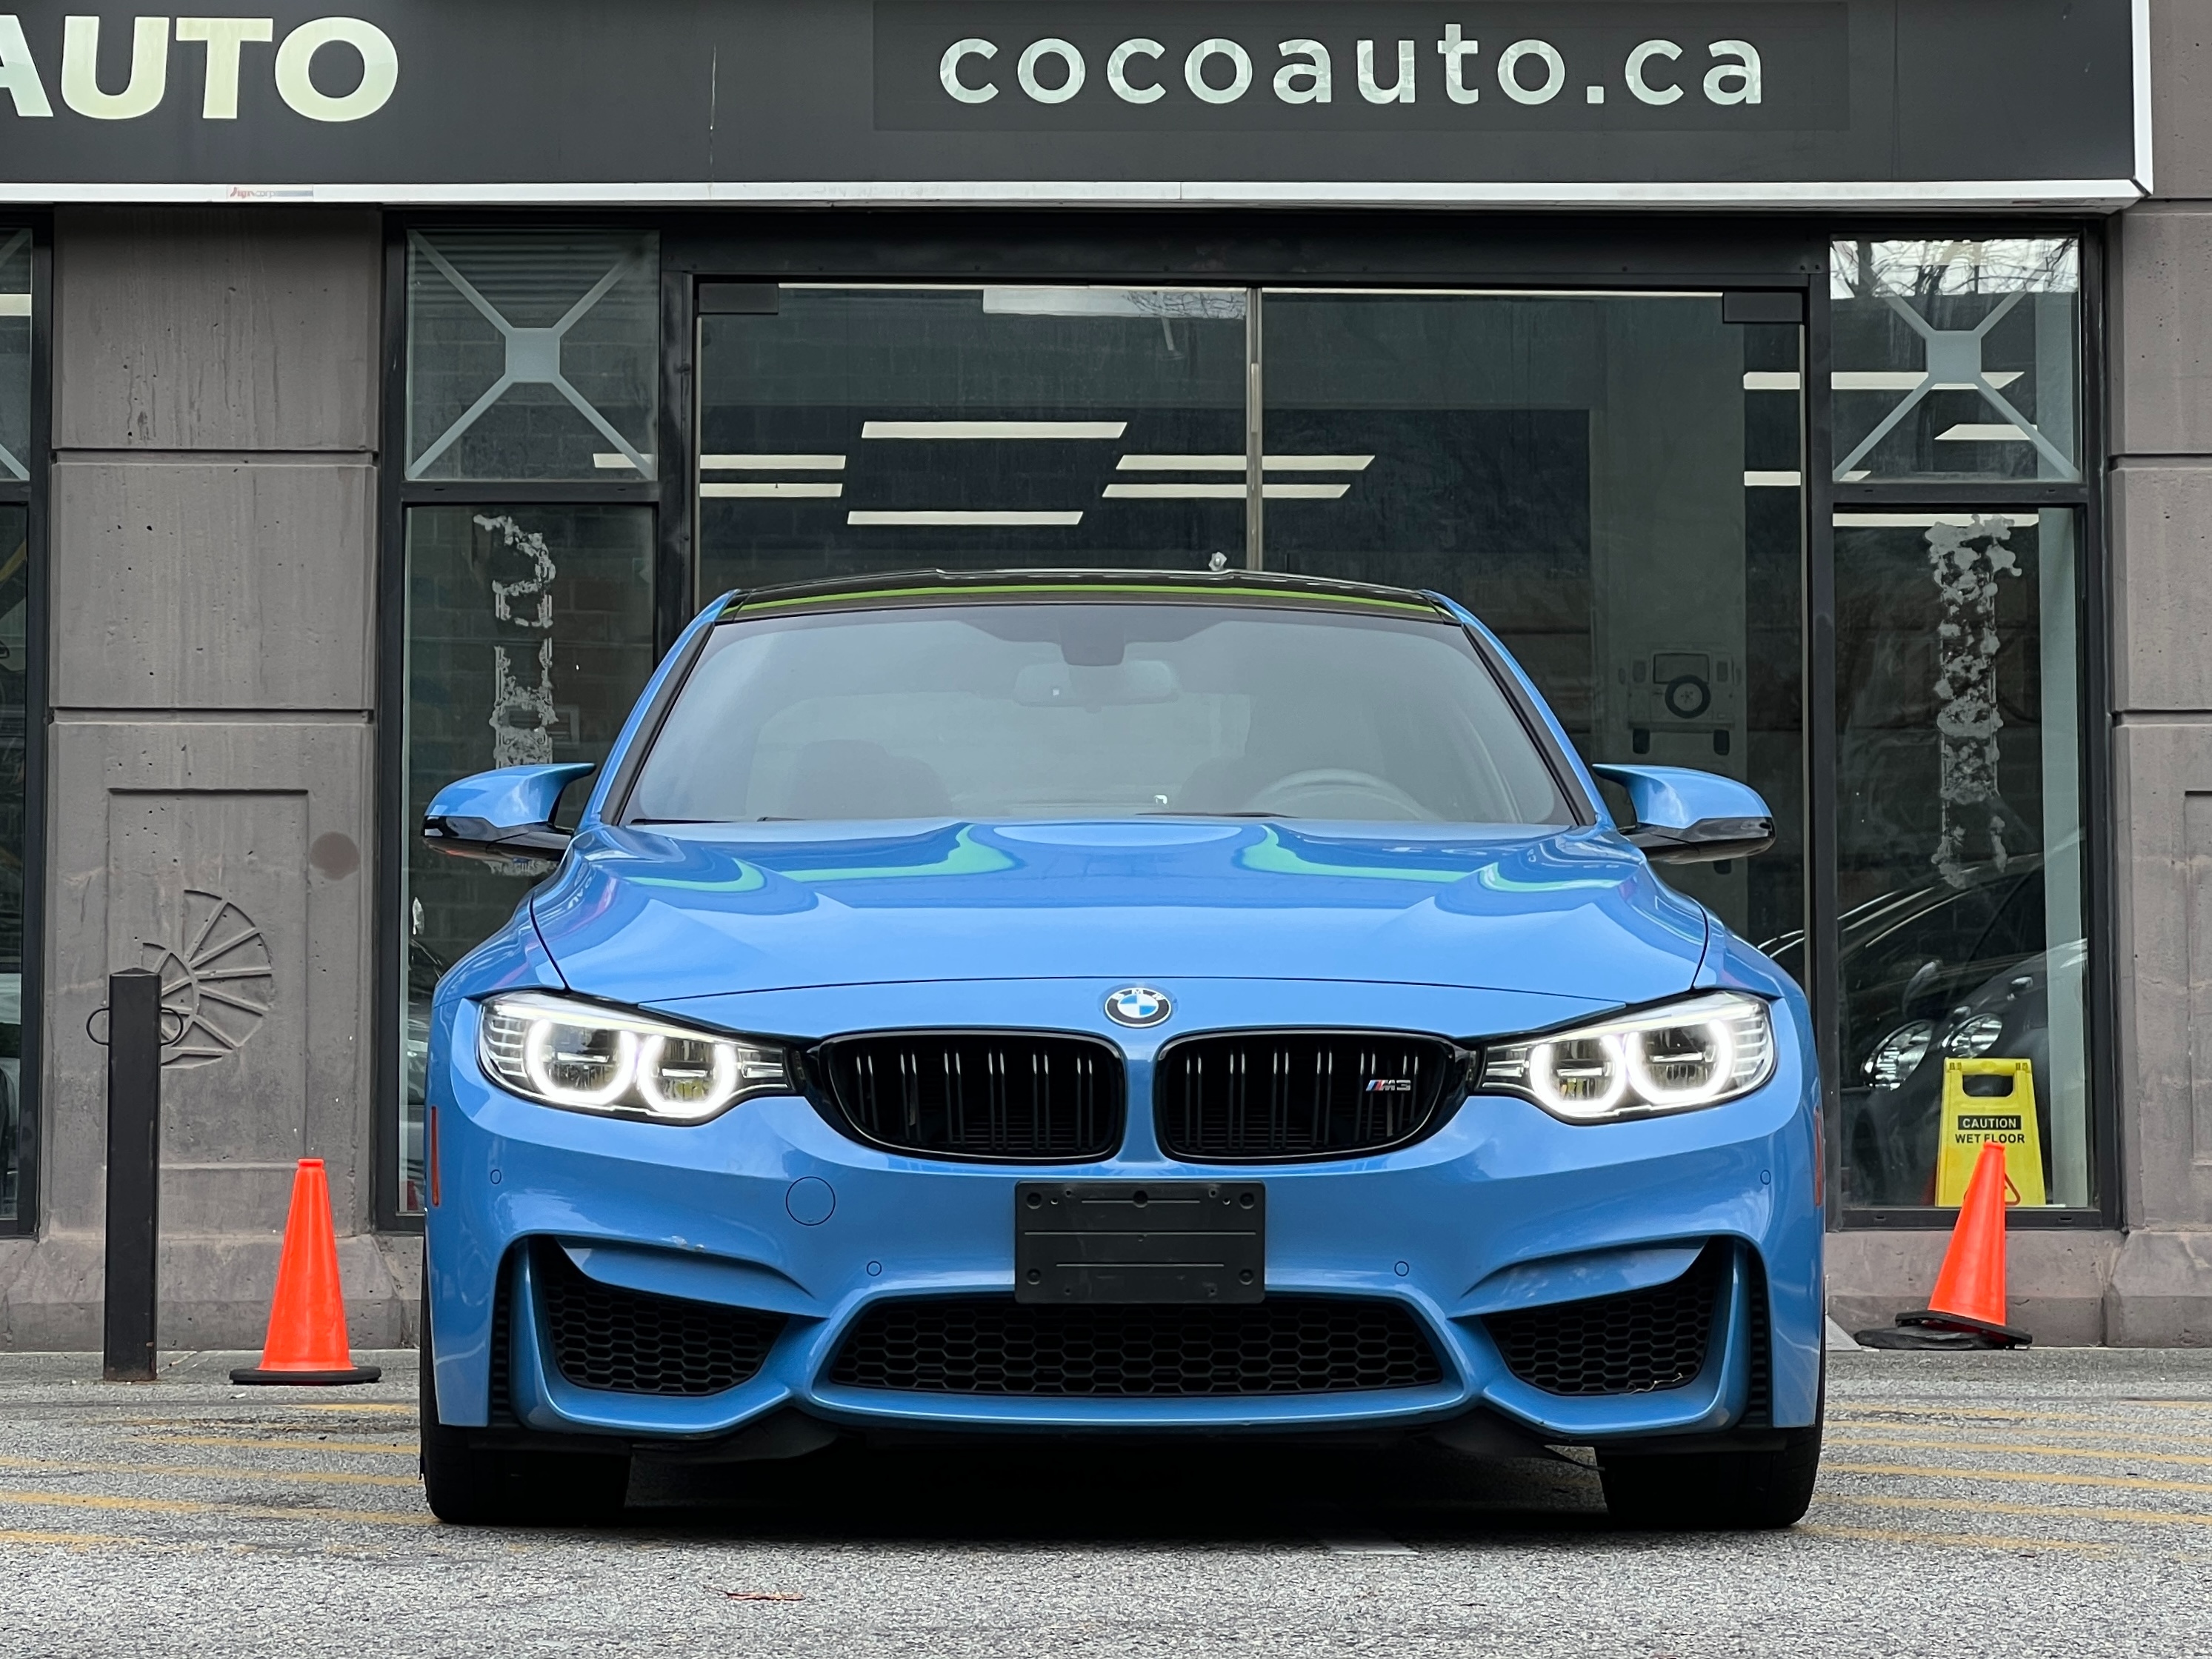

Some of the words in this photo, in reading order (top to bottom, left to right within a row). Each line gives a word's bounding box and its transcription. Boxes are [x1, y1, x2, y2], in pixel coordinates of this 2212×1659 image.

[939, 23, 1762, 106] cocoauto.ca
[1376, 1079, 1411, 1092] M3
[1962, 1118, 2016, 1129] CAUTION
[1955, 1133, 1981, 1144] WET
[1984, 1133, 2025, 1144] FLOOR
